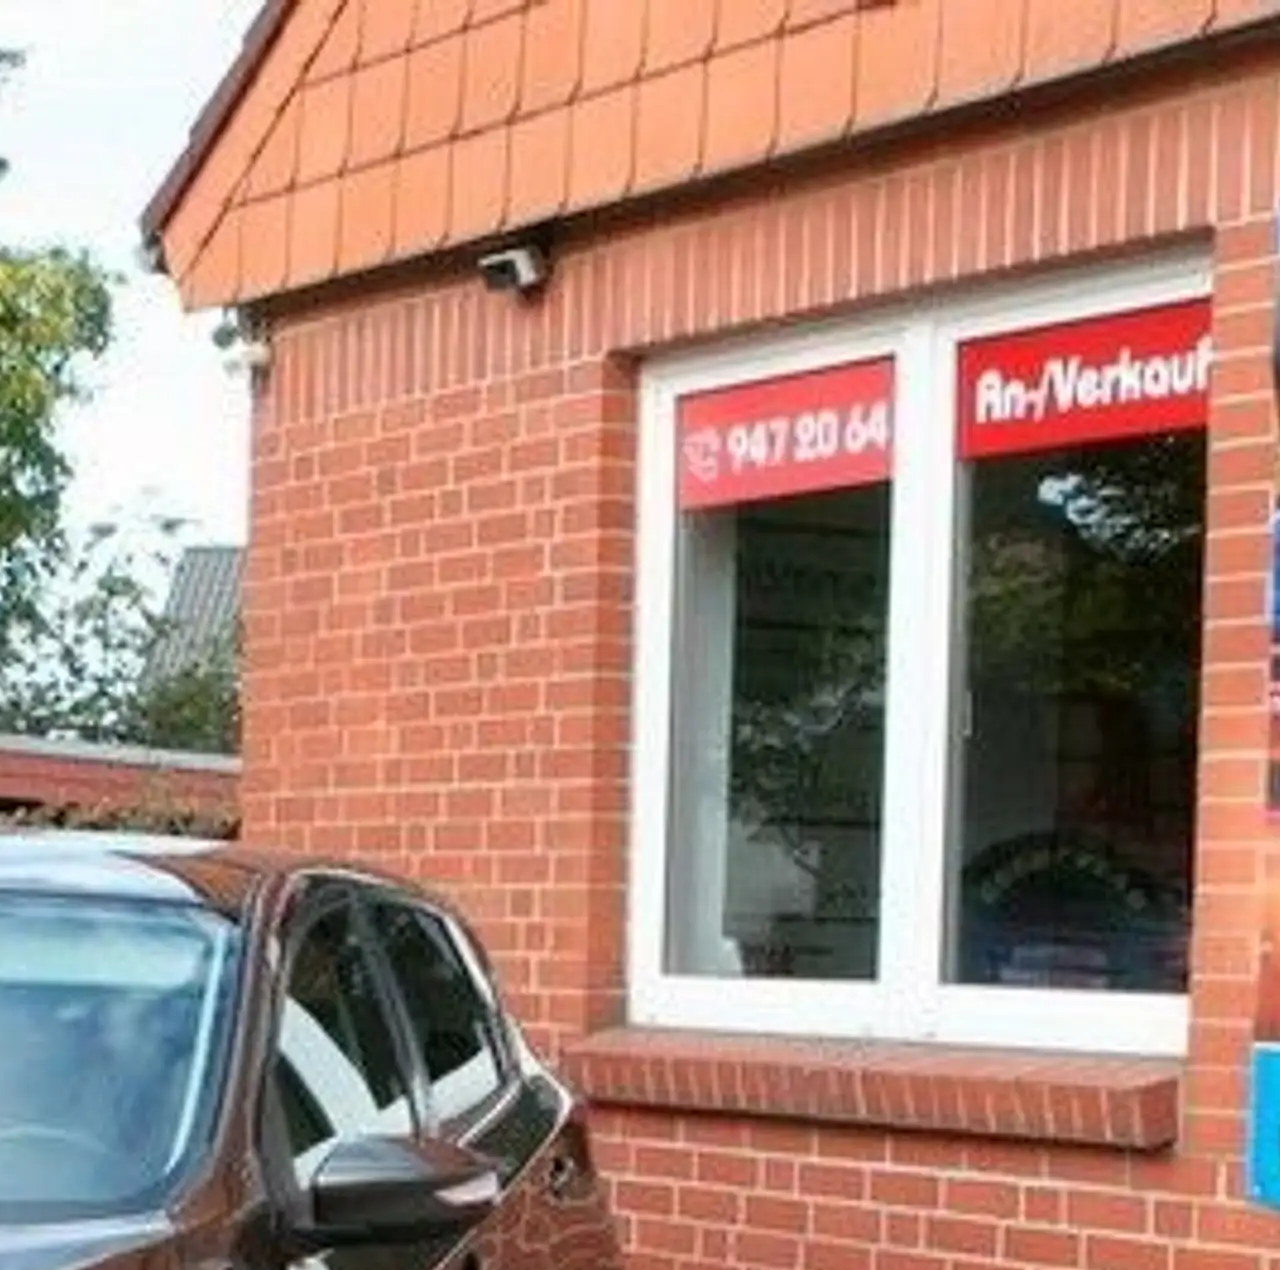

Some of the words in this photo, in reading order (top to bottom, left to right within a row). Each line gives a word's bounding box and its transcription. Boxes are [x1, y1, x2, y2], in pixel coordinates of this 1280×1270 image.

[975, 335, 1213, 423] An-/Verkauf
[726, 420, 790, 474] 947
[795, 409, 839, 461] 20
[845, 400, 890, 455] 64
